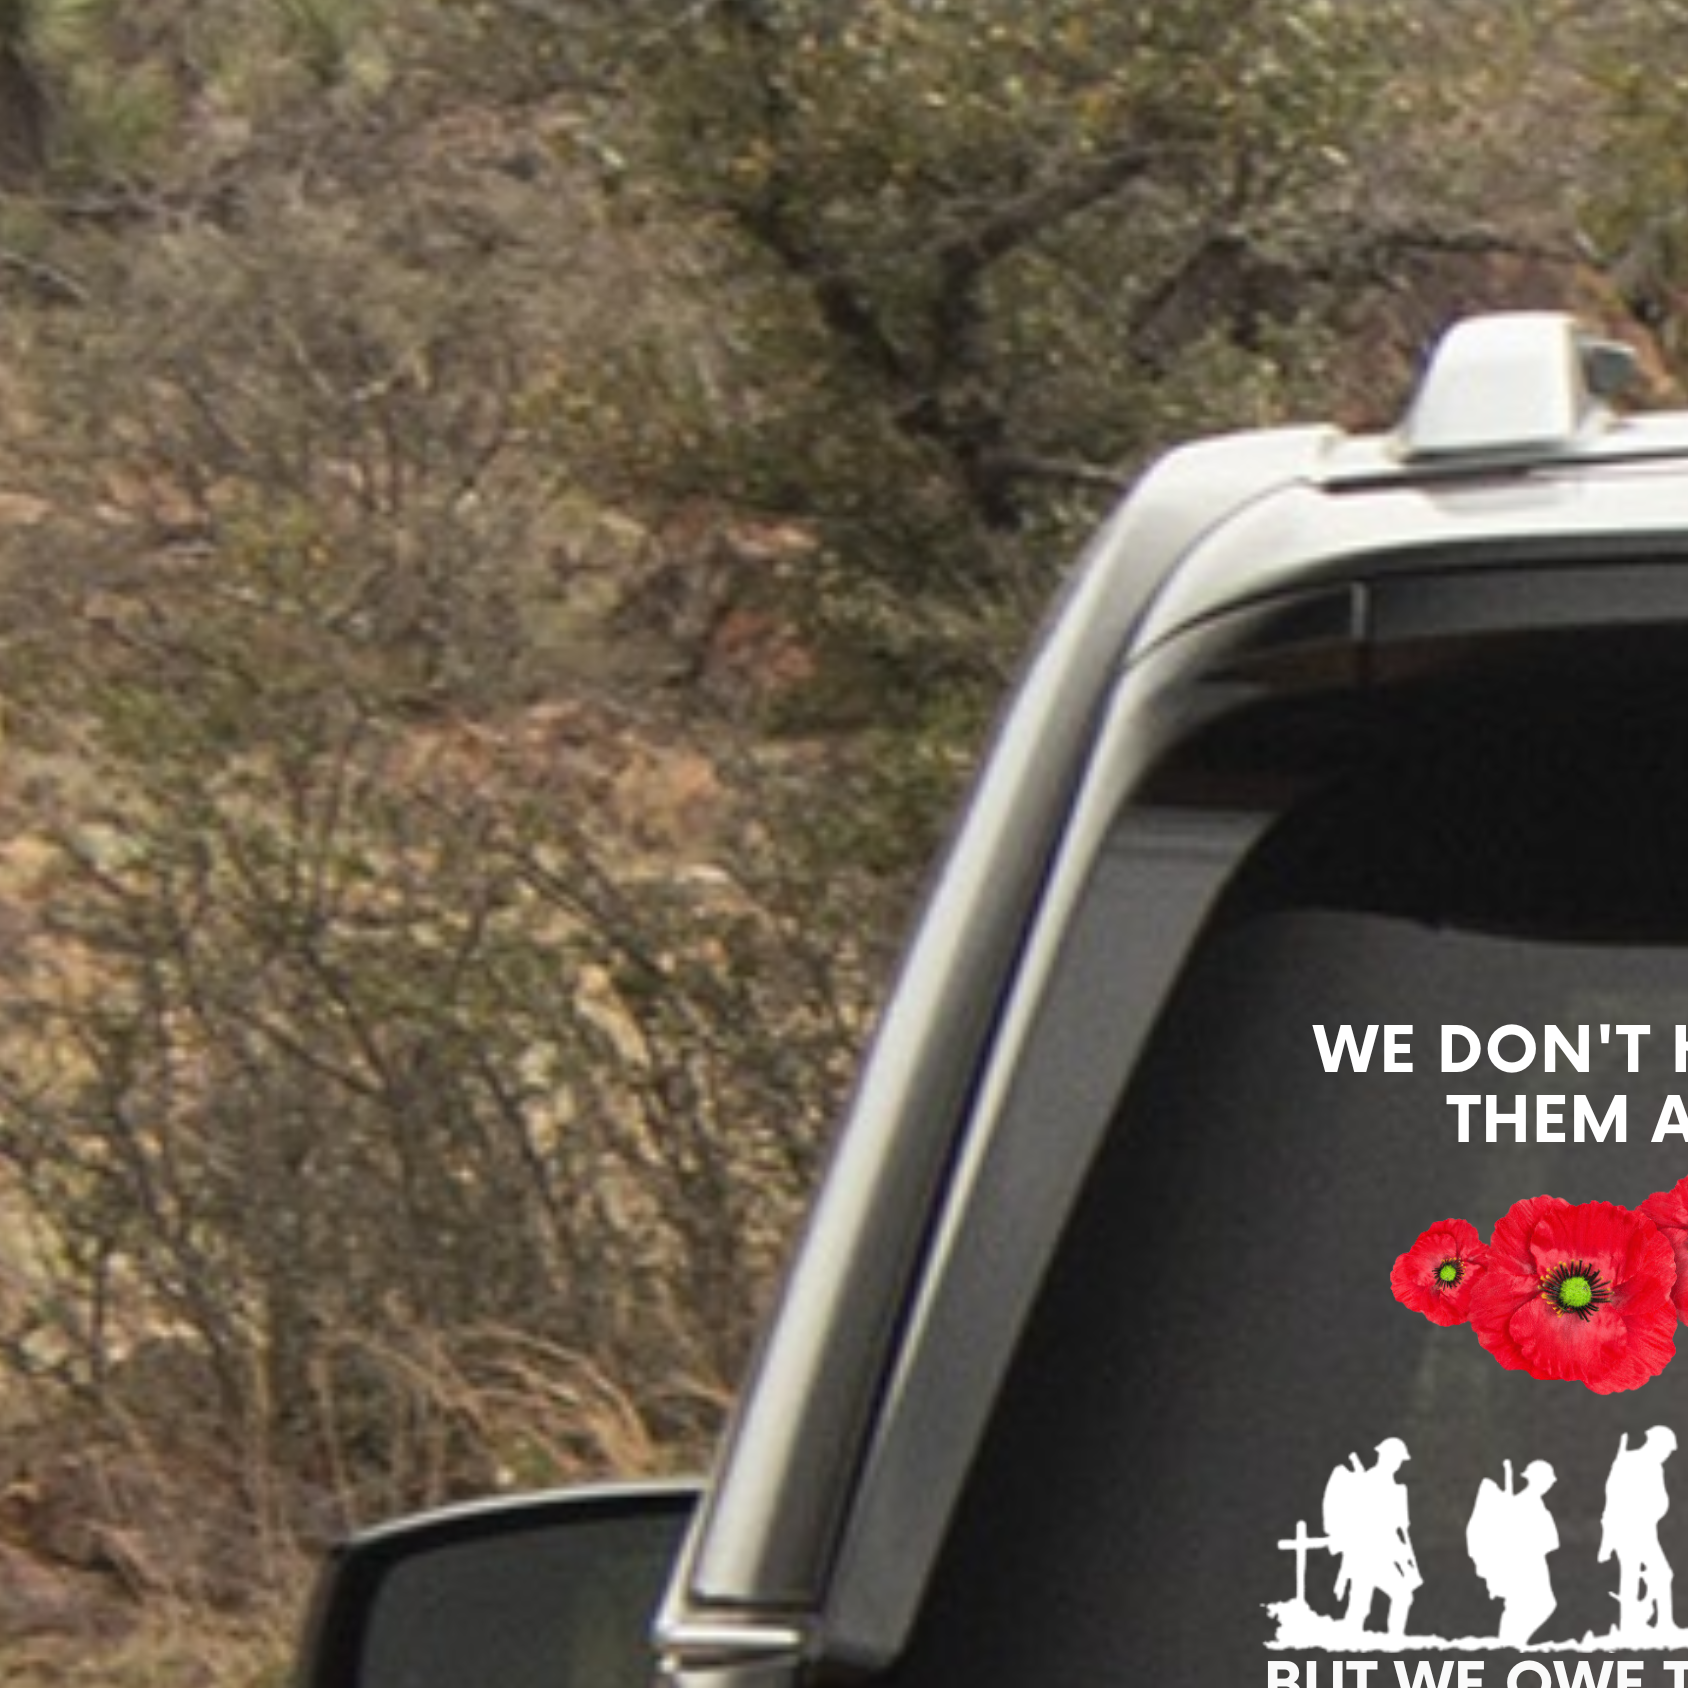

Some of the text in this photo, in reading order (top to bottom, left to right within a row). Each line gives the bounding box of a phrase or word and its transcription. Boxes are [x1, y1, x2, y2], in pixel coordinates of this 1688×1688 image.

[1312, 1025, 1413, 1072] WE
[1442, 1024, 1650, 1073] DON'T
[1446, 1095, 1626, 1142] THEM
